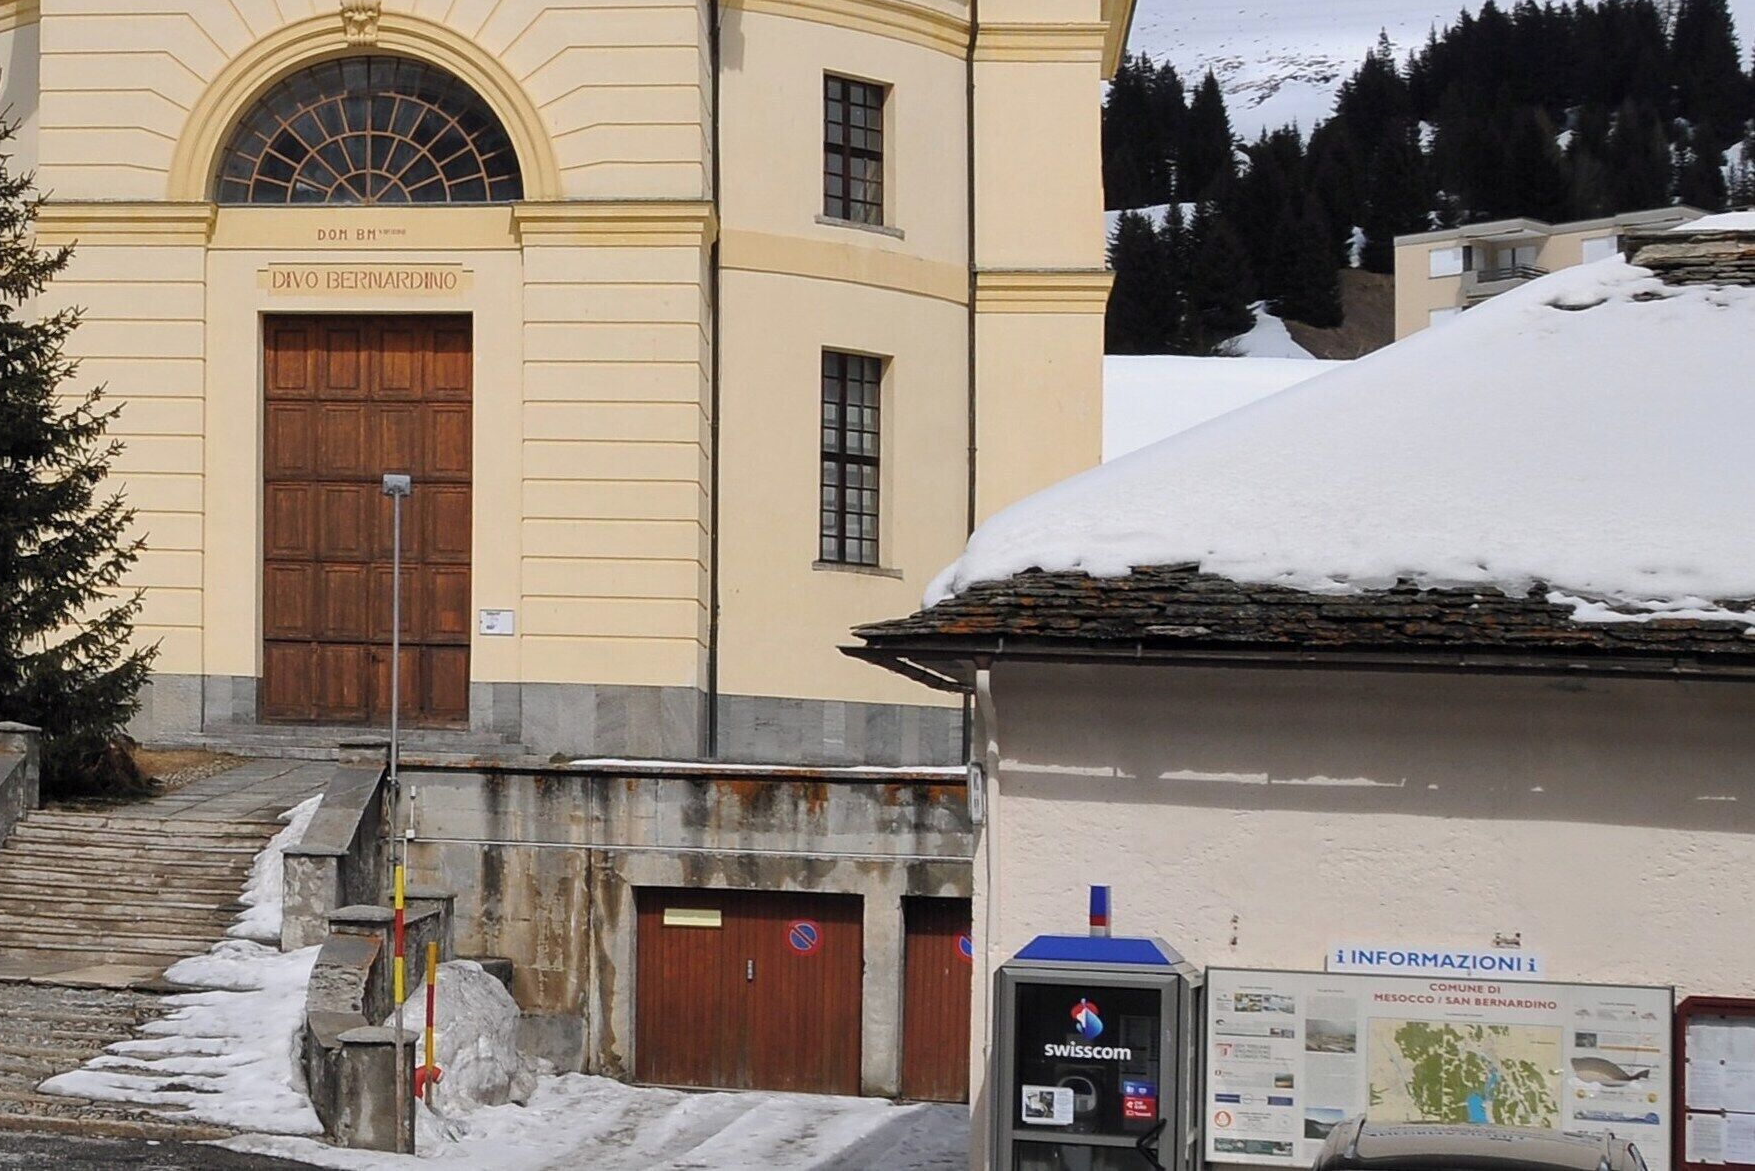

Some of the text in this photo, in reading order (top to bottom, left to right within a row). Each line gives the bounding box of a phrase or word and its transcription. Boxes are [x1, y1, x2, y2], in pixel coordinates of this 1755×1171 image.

[317, 228, 348, 241] DOM
[272, 270, 458, 290] DIVO BERNARDINO
[1351, 949, 1522, 972] INFORMAZIONI
[1429, 982, 1501, 994] COMUNE DI
[1373, 993, 1435, 1004] MESOCCO
[1445, 996, 1471, 1006] SAN
[1474, 998, 1558, 1010] BERNARDINO
[1044, 1040, 1132, 1061] swisscom
